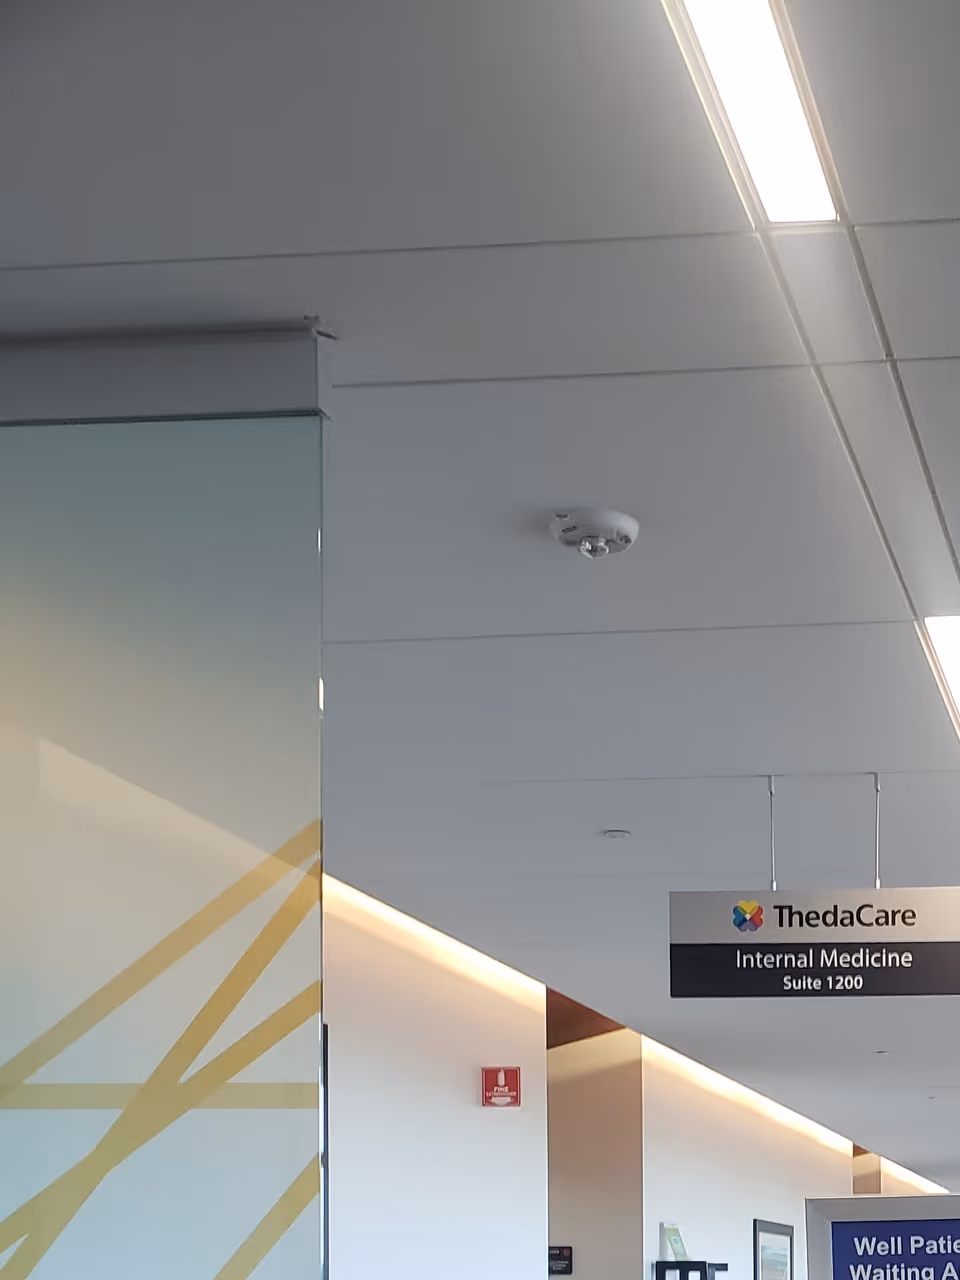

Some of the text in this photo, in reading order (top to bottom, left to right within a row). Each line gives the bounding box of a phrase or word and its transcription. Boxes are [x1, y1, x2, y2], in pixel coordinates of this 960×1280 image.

[773, 903, 917, 928] ThedaCare
[736, 948, 913, 969] Internal Medicine
[783, 975, 864, 990] Suite 1200
[853, 1236, 902, 1256] Well
